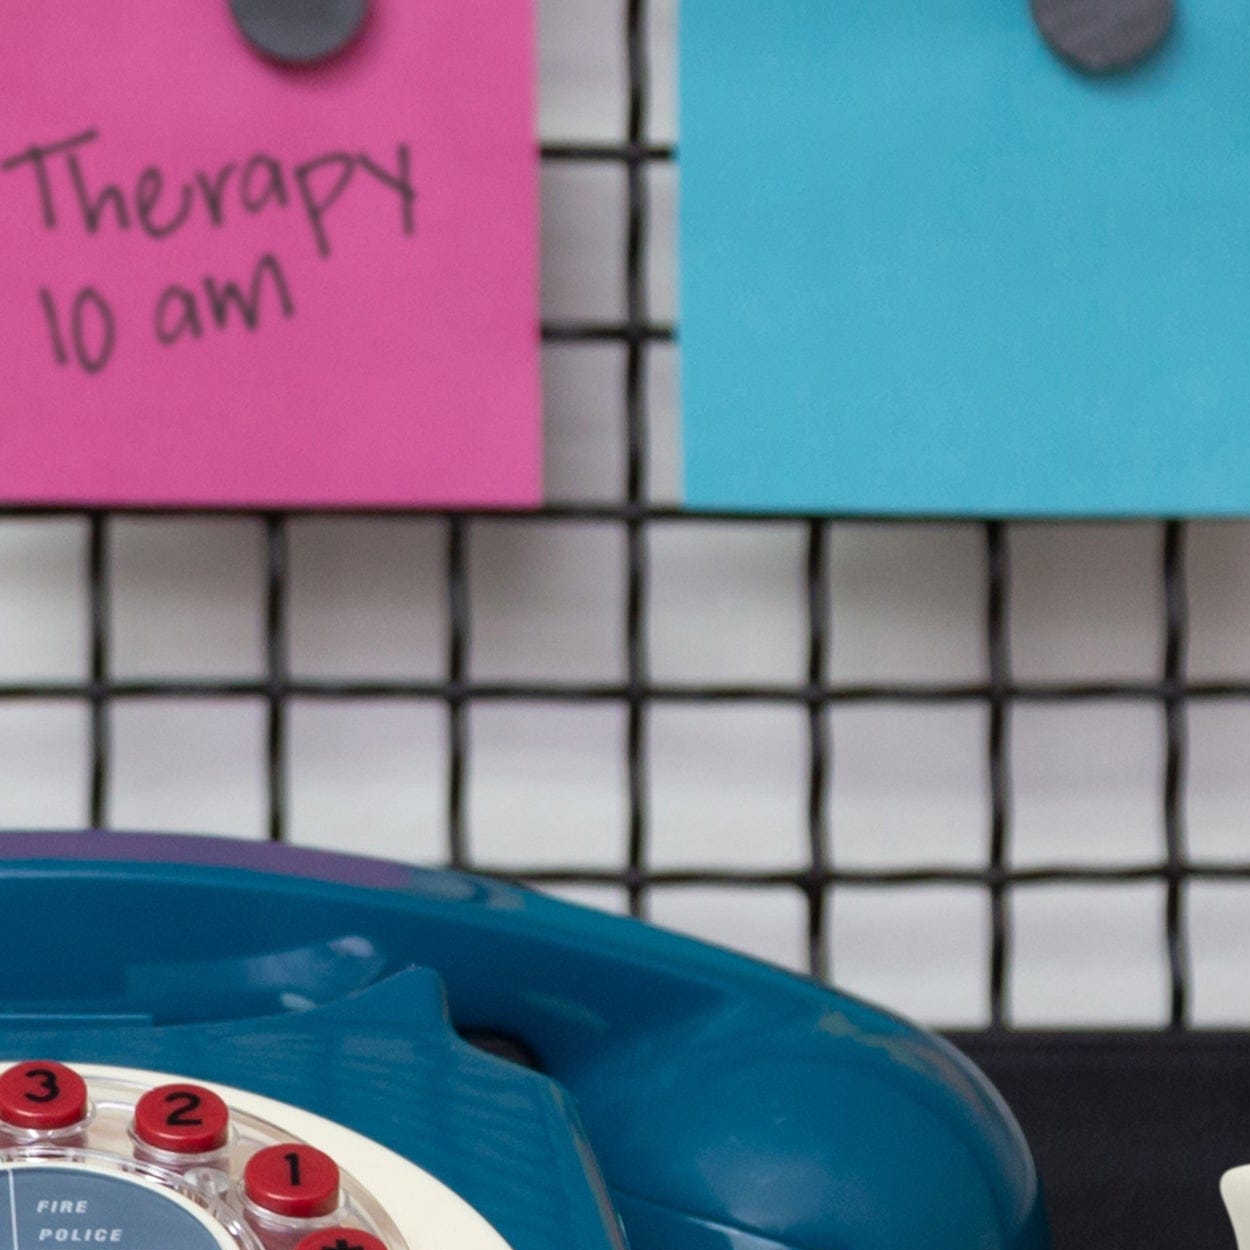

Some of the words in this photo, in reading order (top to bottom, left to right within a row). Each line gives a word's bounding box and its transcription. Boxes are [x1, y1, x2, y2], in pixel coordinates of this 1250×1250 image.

[0, 127, 417, 260] Therapy
[40, 286, 117, 376] 10
[153, 252, 295, 346] am
[24, 1069, 60, 1102] 3
[165, 1091, 203, 1126] 2
[283, 1151, 301, 1187] 1
[36, 1200, 88, 1215] FIRE
[39, 1228, 123, 1243] POLICE
